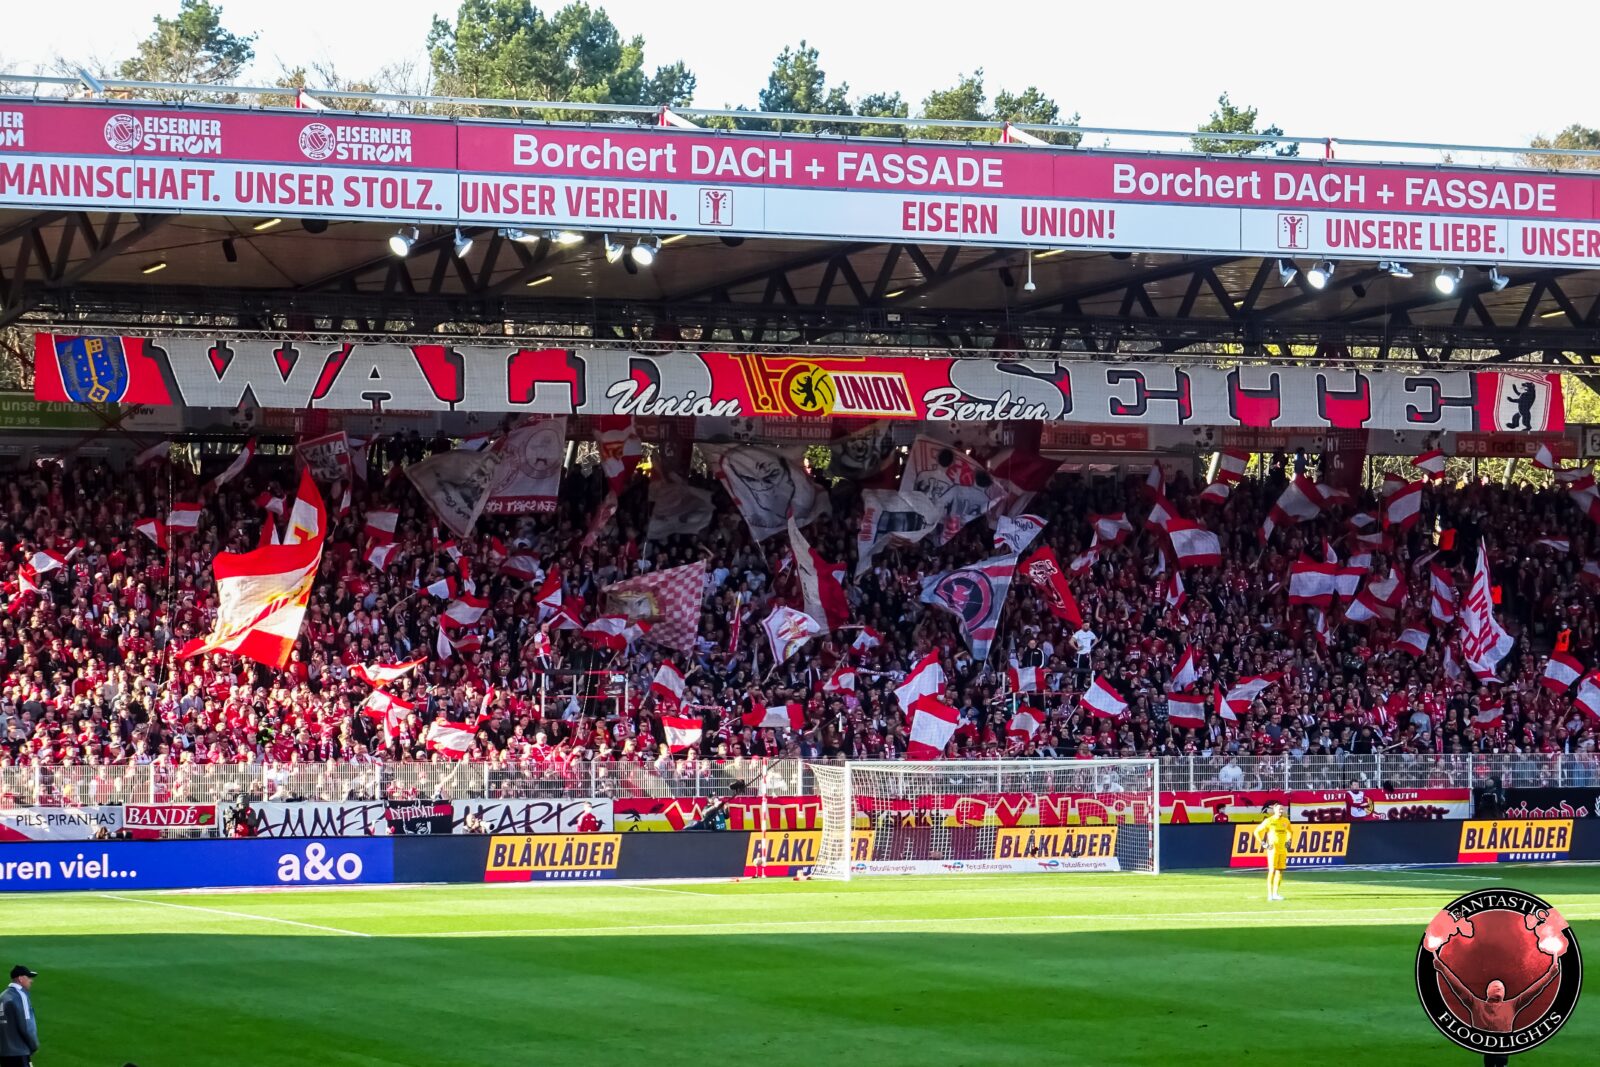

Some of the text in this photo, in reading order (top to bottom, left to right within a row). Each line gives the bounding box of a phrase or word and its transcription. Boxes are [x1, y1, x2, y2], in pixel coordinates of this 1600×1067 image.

[143, 116, 221, 136] EISERNER
[336, 125, 412, 145] EISERNER
[143, 134, 222, 154] STROM
[336, 144, 412, 163] STROM
[513, 133, 1004, 188] Borchert DACH + FASSADE
[0, 162, 443, 211] MANNSCHAFT. UNSER STOLZ.
[1113, 163, 1557, 212] Borchert DACH + FASSADE
[461, 182, 677, 221] UNSER VEREIN.
[902, 201, 1115, 238] EISERN UNION!
[1326, 219, 1600, 257] UNSERE LIEBE. UNSER
[606, 379, 741, 416] Union
[833, 375, 912, 411] UNION
[923, 387, 1048, 421] Berlin
[1384, 792, 1418, 800] YOUTH
[16, 812, 116, 827] PILS-PIRANHAS
[125, 805, 198, 825] BANDÉ
[1000, 829, 1113, 858] BLÅKLÄDER
[1464, 822, 1568, 850] BLÅKLÄDER
[278, 842, 363, 881] a&o
[494, 835, 615, 867] BLÅKLÄDER
[1061, 861, 1107, 869] TotalEnergies
[1509, 852, 1557, 860] WORKWEAR
[60, 853, 137, 879] viel...
[545, 870, 602, 878] WORKWEAR
